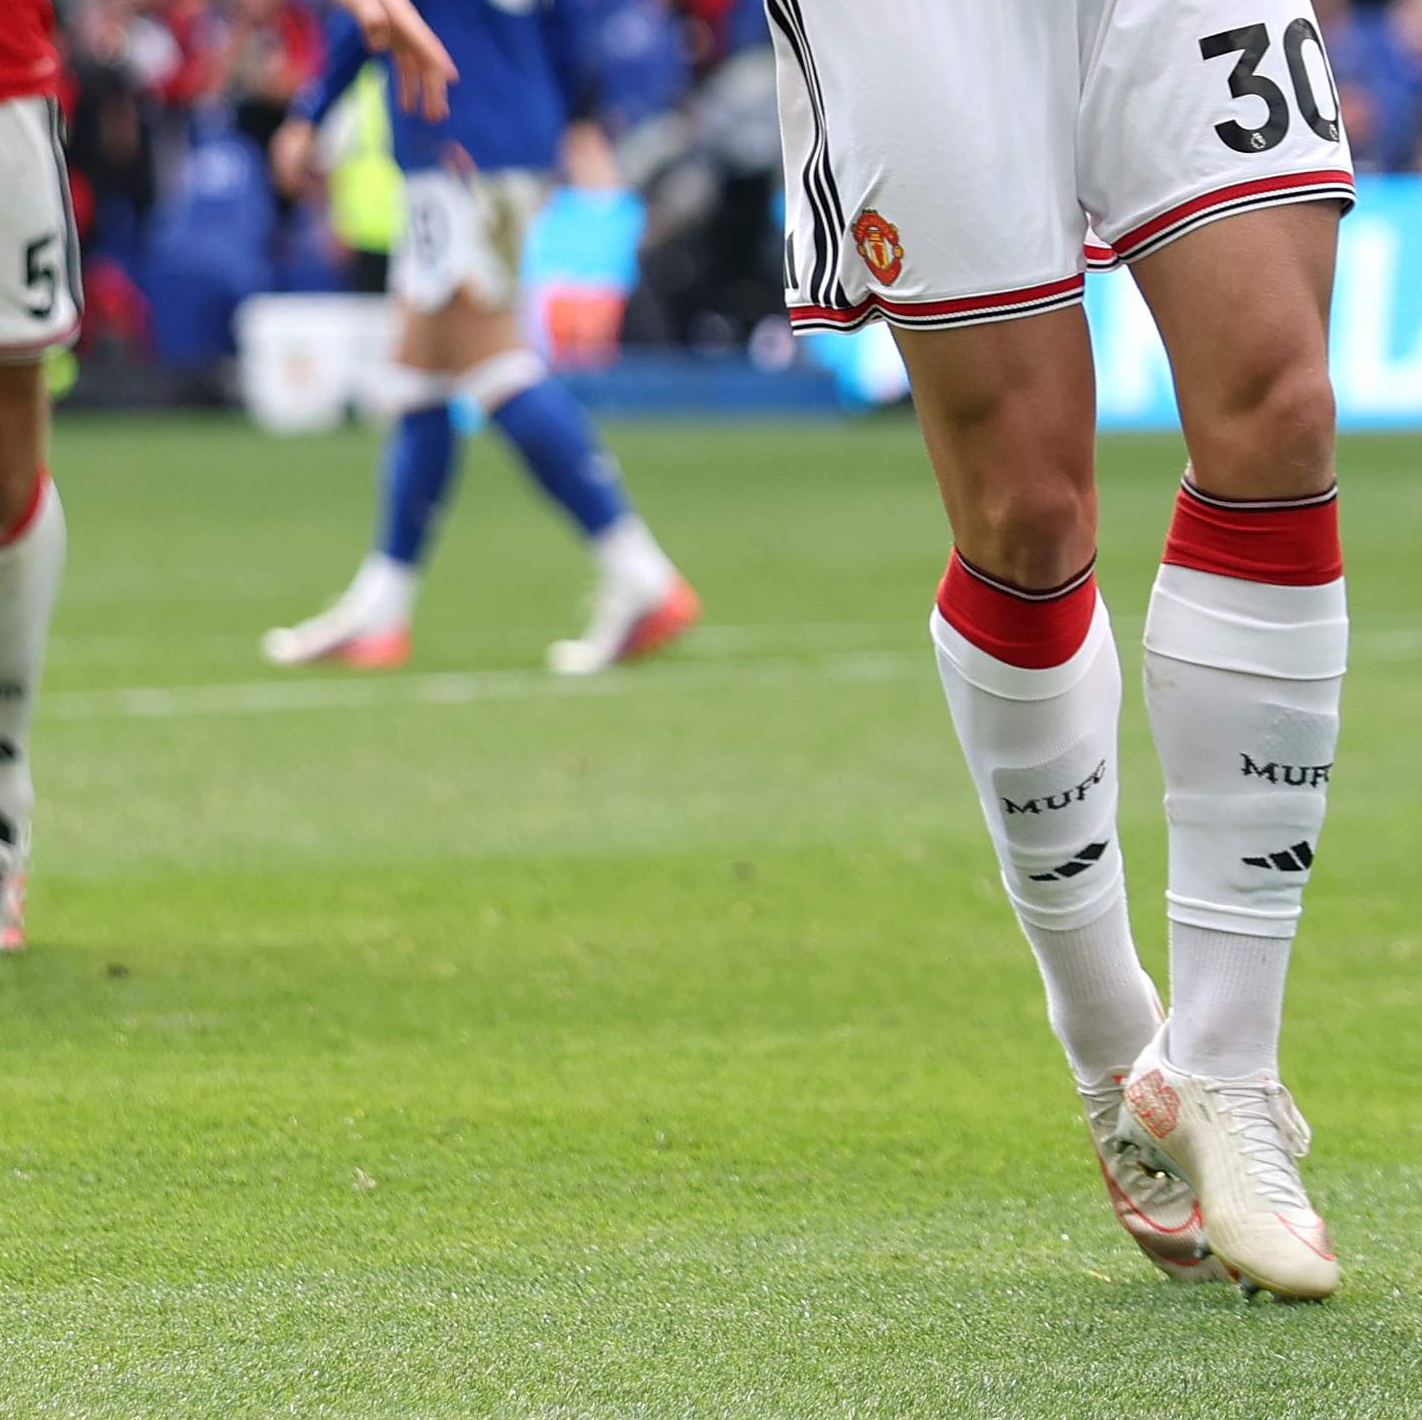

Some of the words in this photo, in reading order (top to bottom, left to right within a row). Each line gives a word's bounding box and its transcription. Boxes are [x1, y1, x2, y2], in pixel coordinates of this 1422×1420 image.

[1198, 17, 1340, 154] 30
[24, 232, 56, 318] 5
[1240, 752, 1334, 789] MUF
